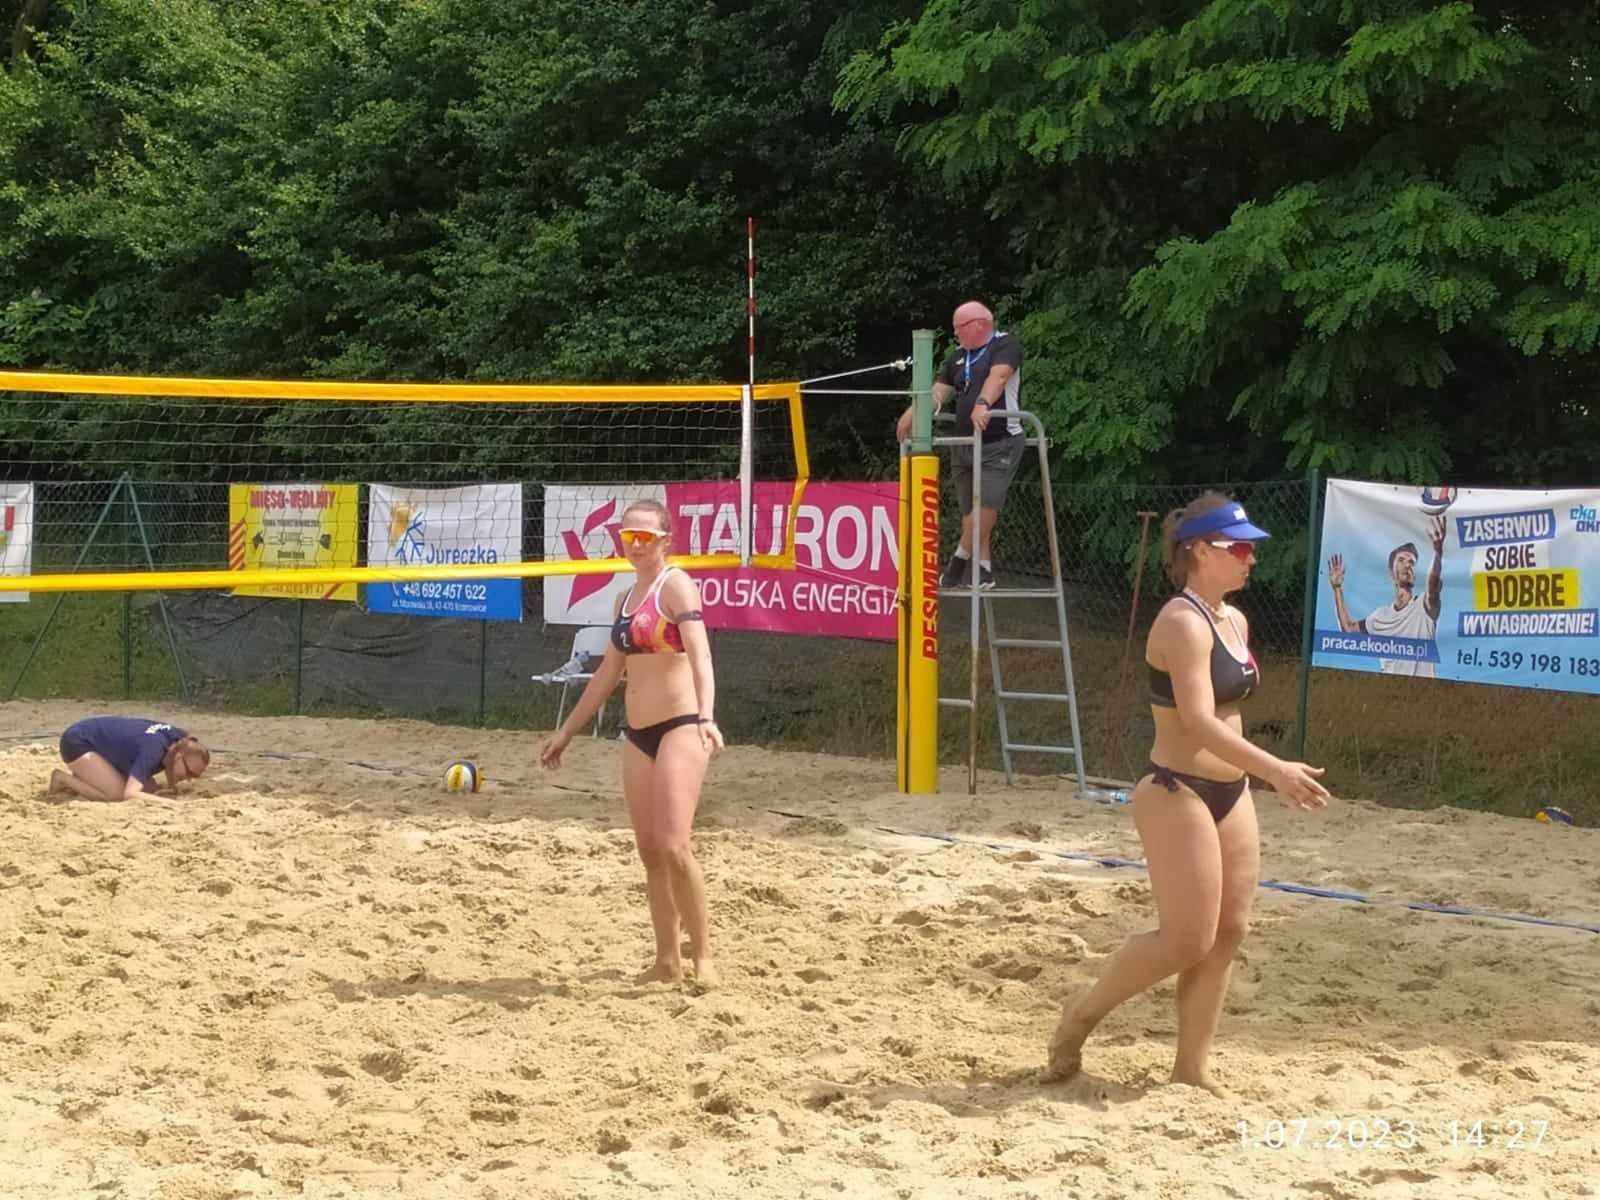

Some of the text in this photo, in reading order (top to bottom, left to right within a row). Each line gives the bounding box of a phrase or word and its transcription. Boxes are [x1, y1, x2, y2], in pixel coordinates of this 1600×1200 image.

[680, 503, 899, 571] TAURON
[1463, 512, 1549, 542] ZASERWUJ
[426, 543, 497, 564] Jureczka
[1484, 544, 1536, 570] SOBIE
[422, 582, 440, 598] 692
[442, 583, 463, 599] 457
[464, 584, 487, 600] 622
[1487, 573, 1565, 608] DOBRE
[1463, 613, 1595, 635] WYNAGRODZENIE!
[1321, 636, 1428, 658] praca.ekookna.pl
[1457, 648, 1600, 677] tel. 539 198 183
